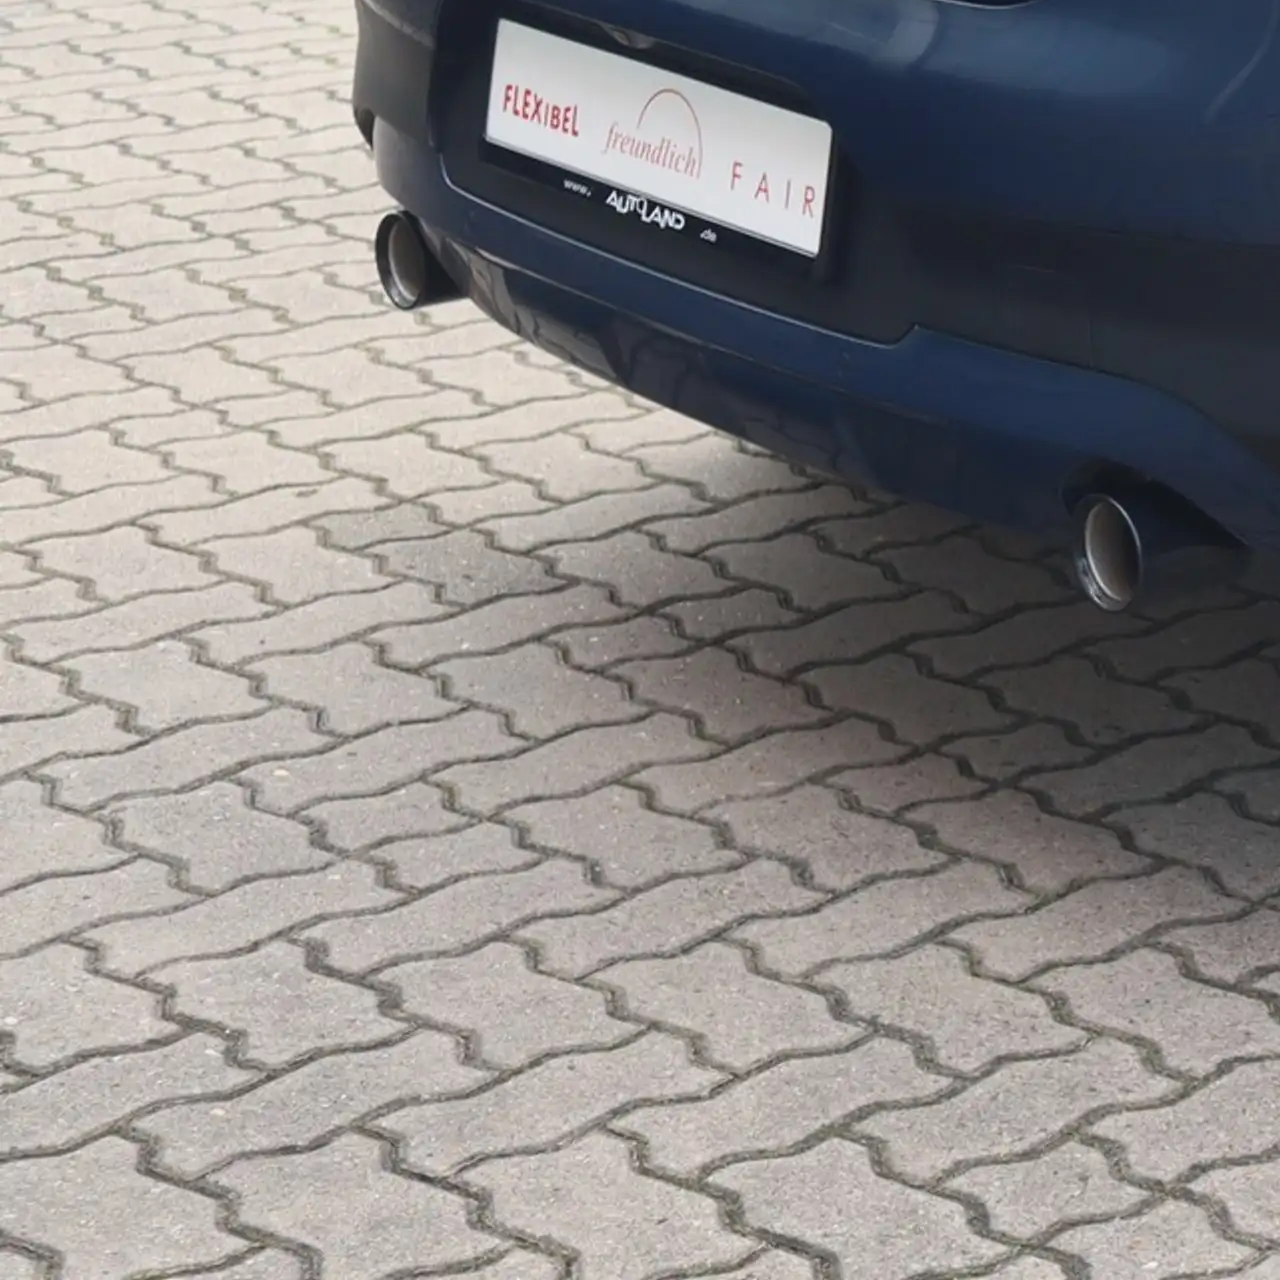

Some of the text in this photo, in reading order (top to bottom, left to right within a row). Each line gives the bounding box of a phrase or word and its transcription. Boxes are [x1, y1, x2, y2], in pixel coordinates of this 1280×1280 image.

[502, 84, 580, 137] FLEXIBEL
[602, 121, 699, 178] freundlich
[606, 189, 686, 231] AUTOLAND
